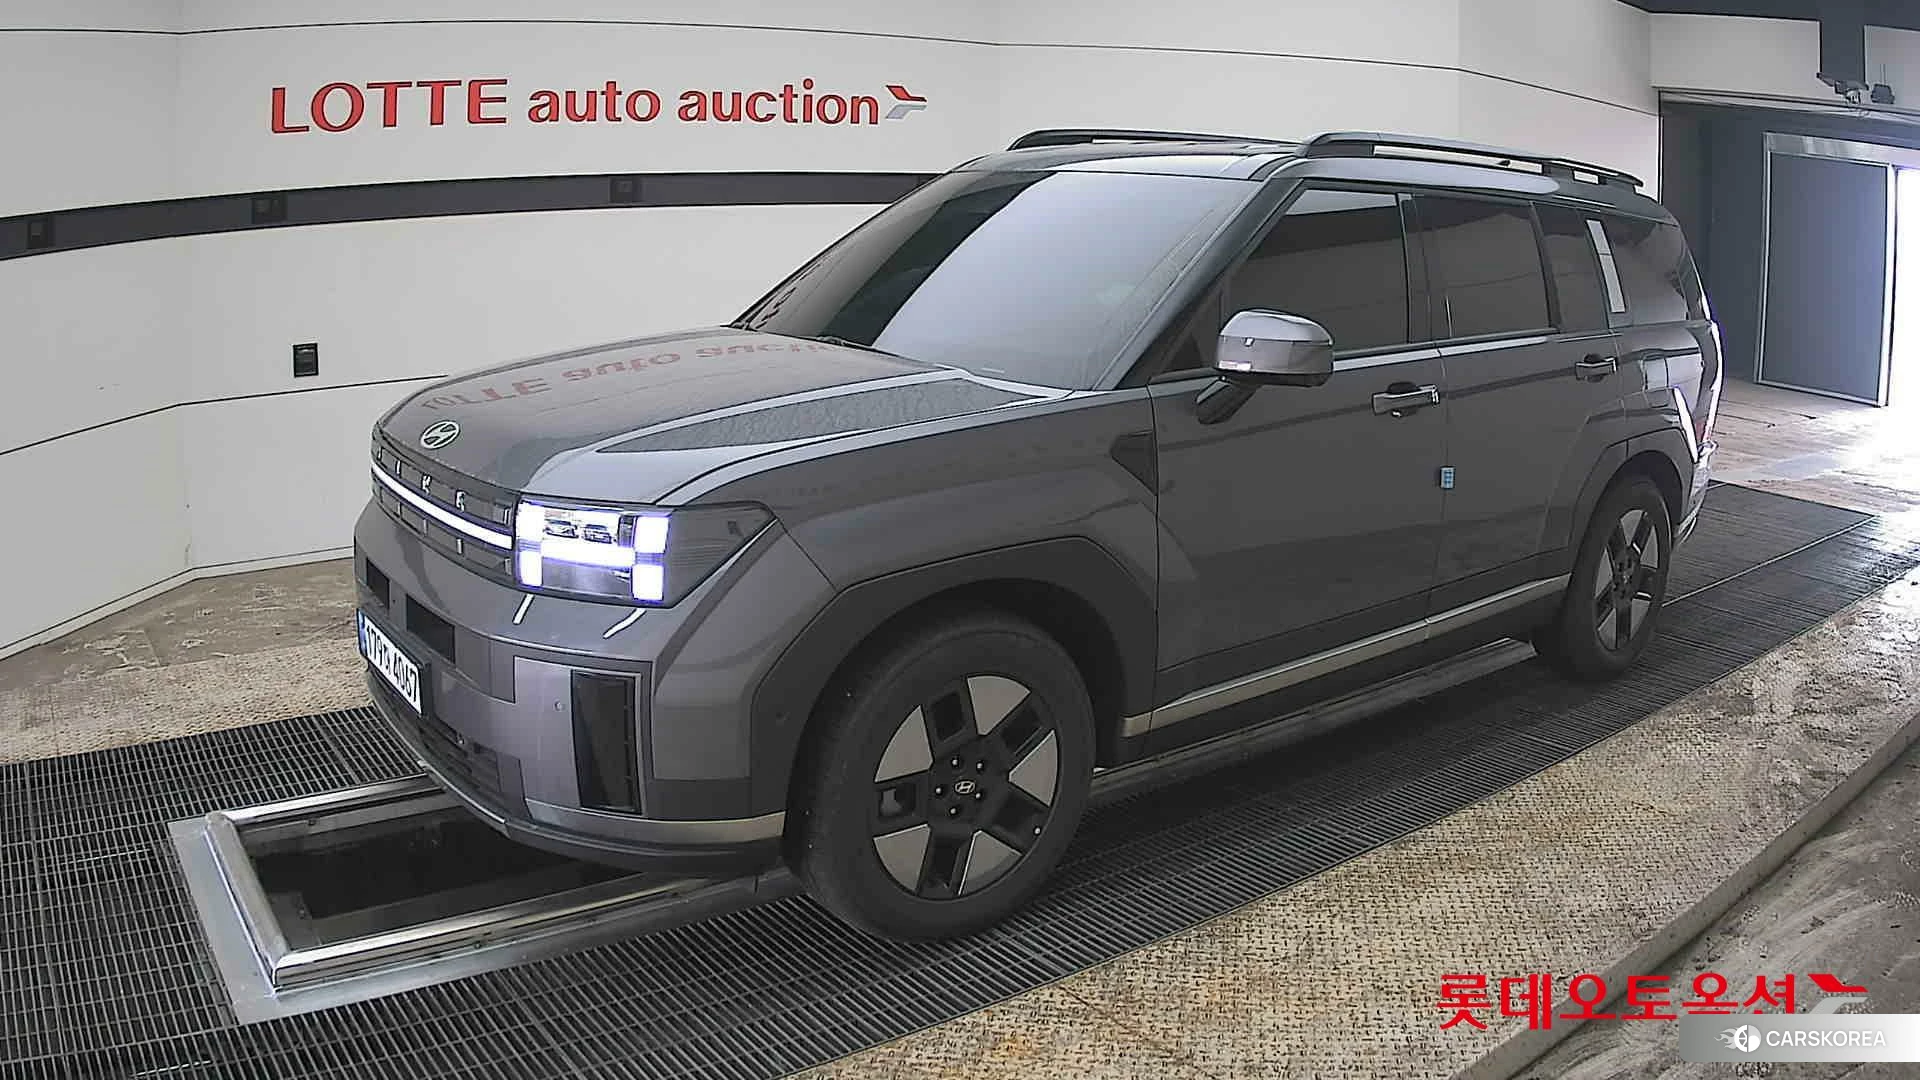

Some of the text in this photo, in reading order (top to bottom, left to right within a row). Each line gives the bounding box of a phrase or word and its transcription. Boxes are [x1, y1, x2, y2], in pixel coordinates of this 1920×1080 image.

[271, 78, 879, 134] LOTTE auto auction
